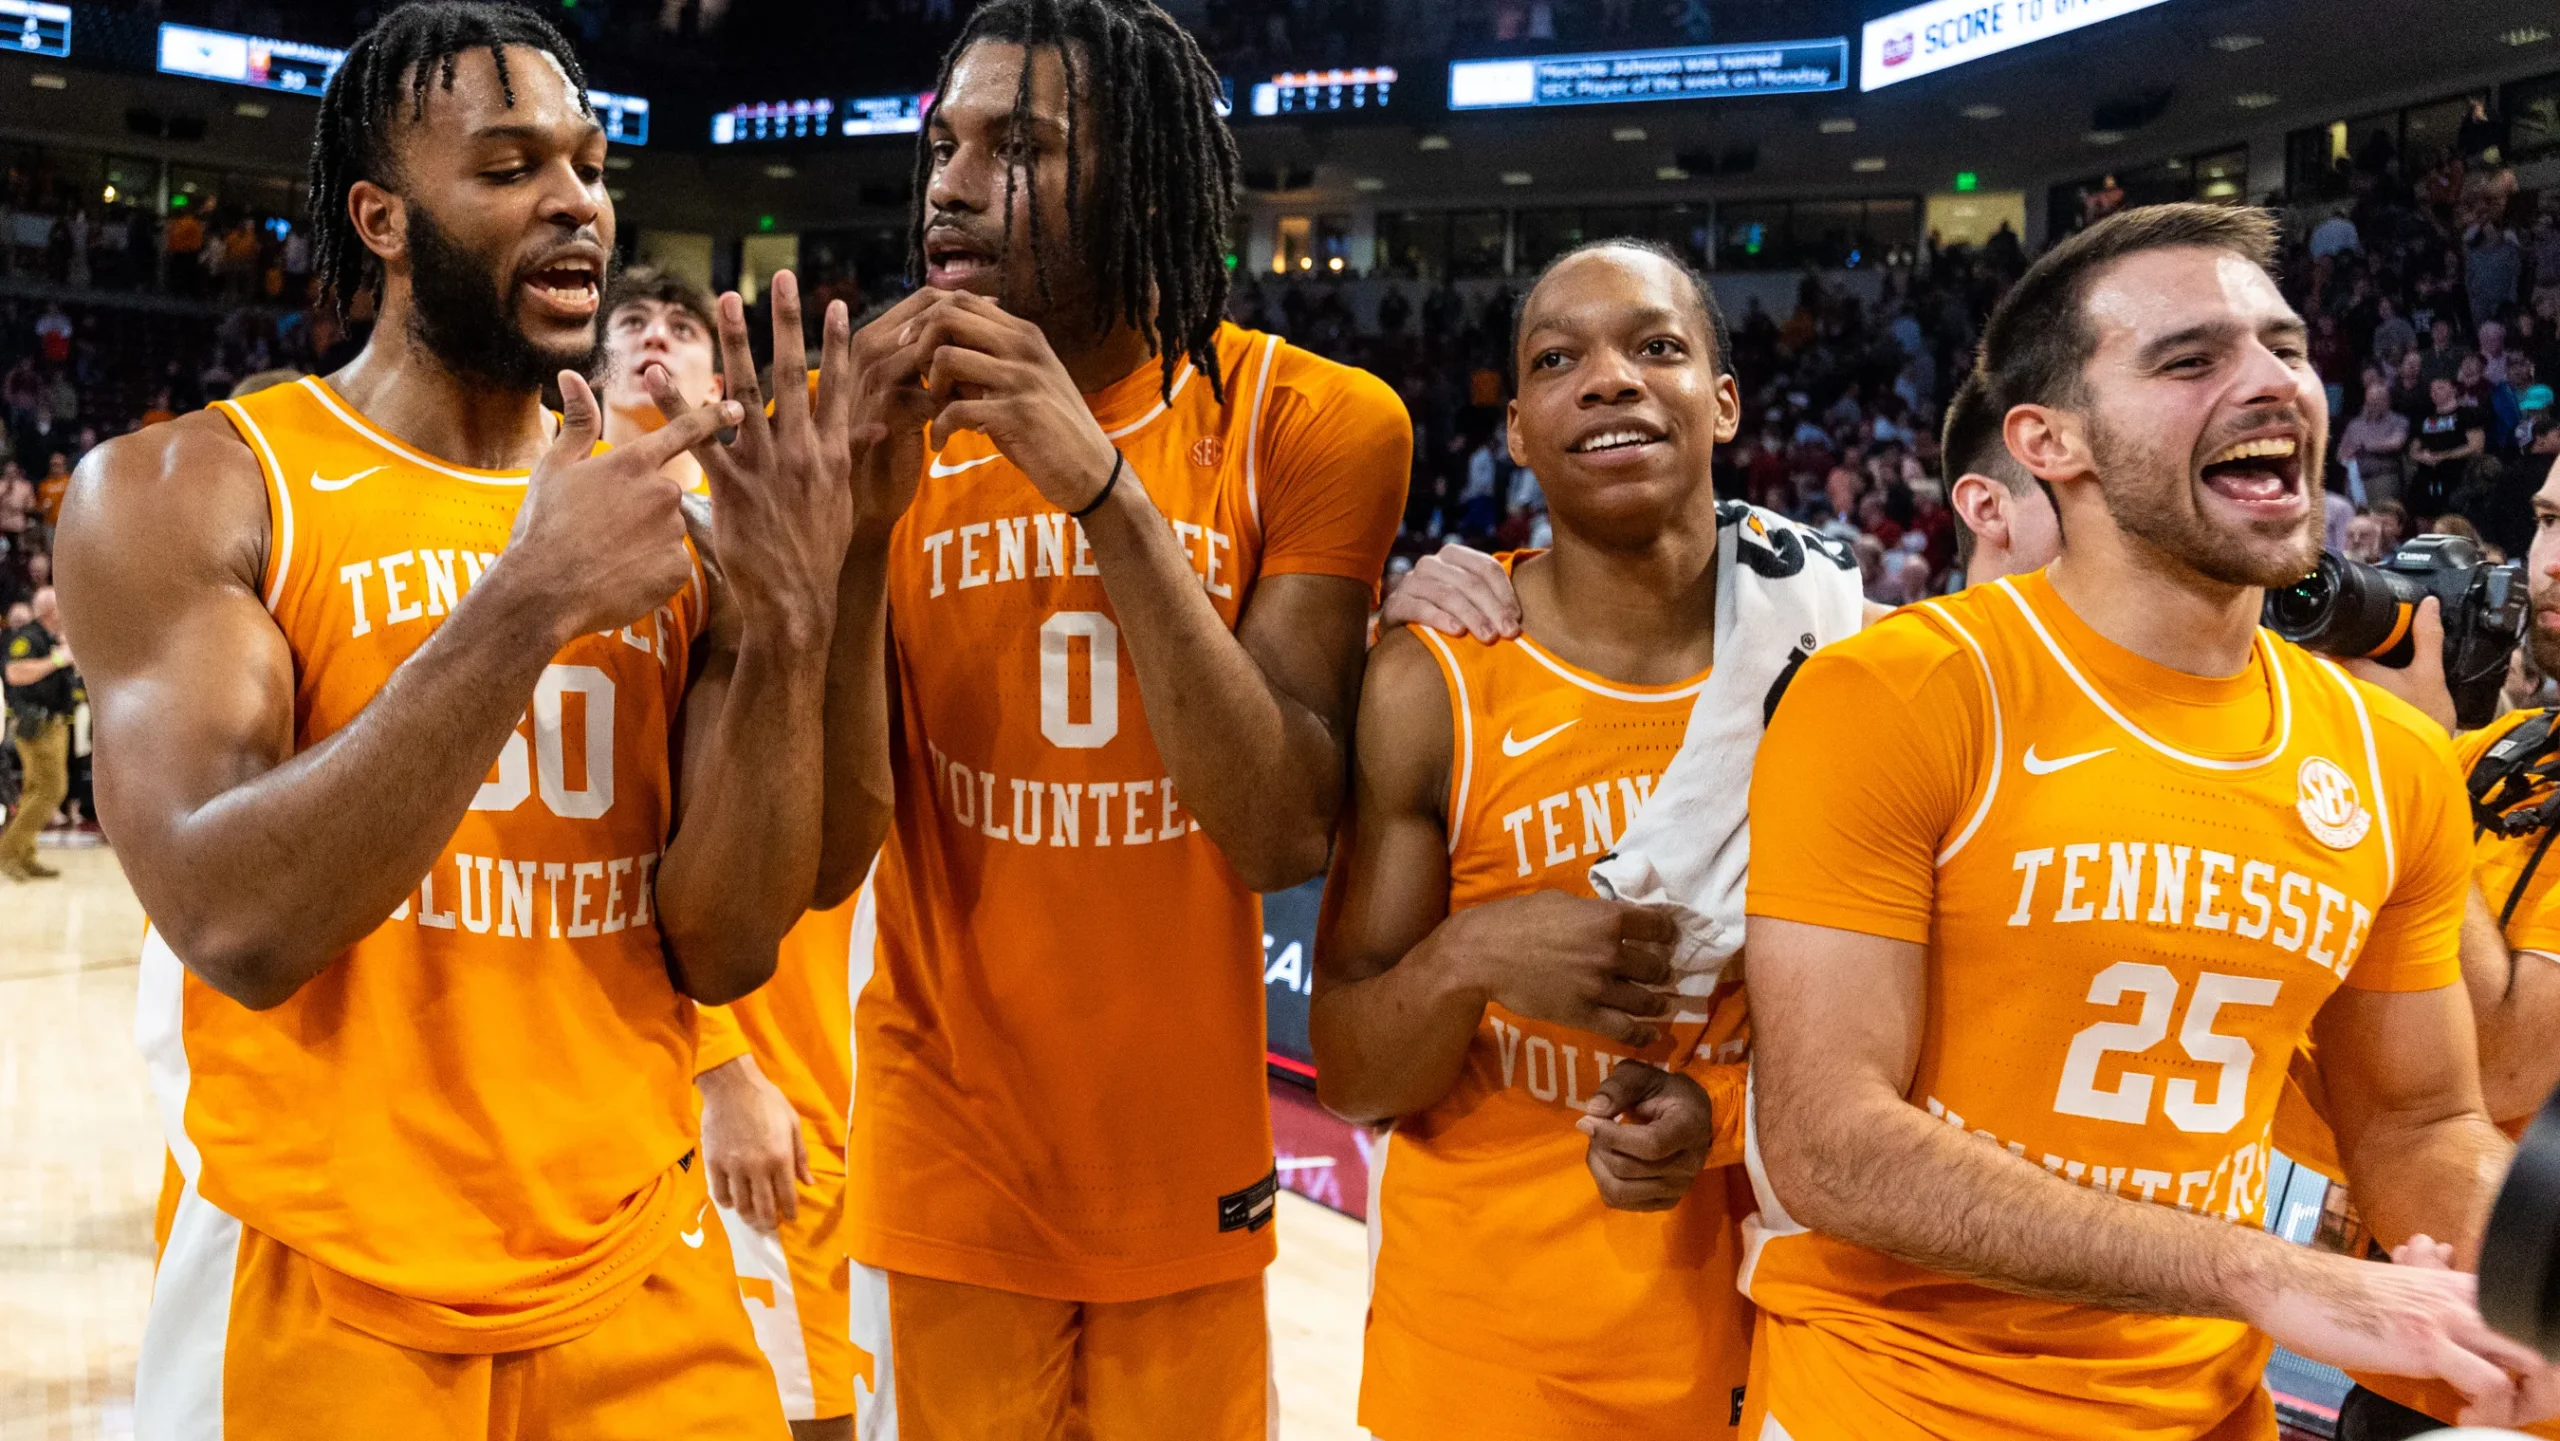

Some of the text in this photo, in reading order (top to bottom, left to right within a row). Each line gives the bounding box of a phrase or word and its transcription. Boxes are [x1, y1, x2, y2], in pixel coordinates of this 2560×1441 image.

[1925, 3, 2004, 53] SCORE
[2396, 551, 2432, 562] Canon
[1040, 611, 1118, 748] 0
[2301, 761, 2353, 824] SEC
[2007, 842, 2371, 982] TENNESSEE
[2054, 961, 2283, 1134] 25
